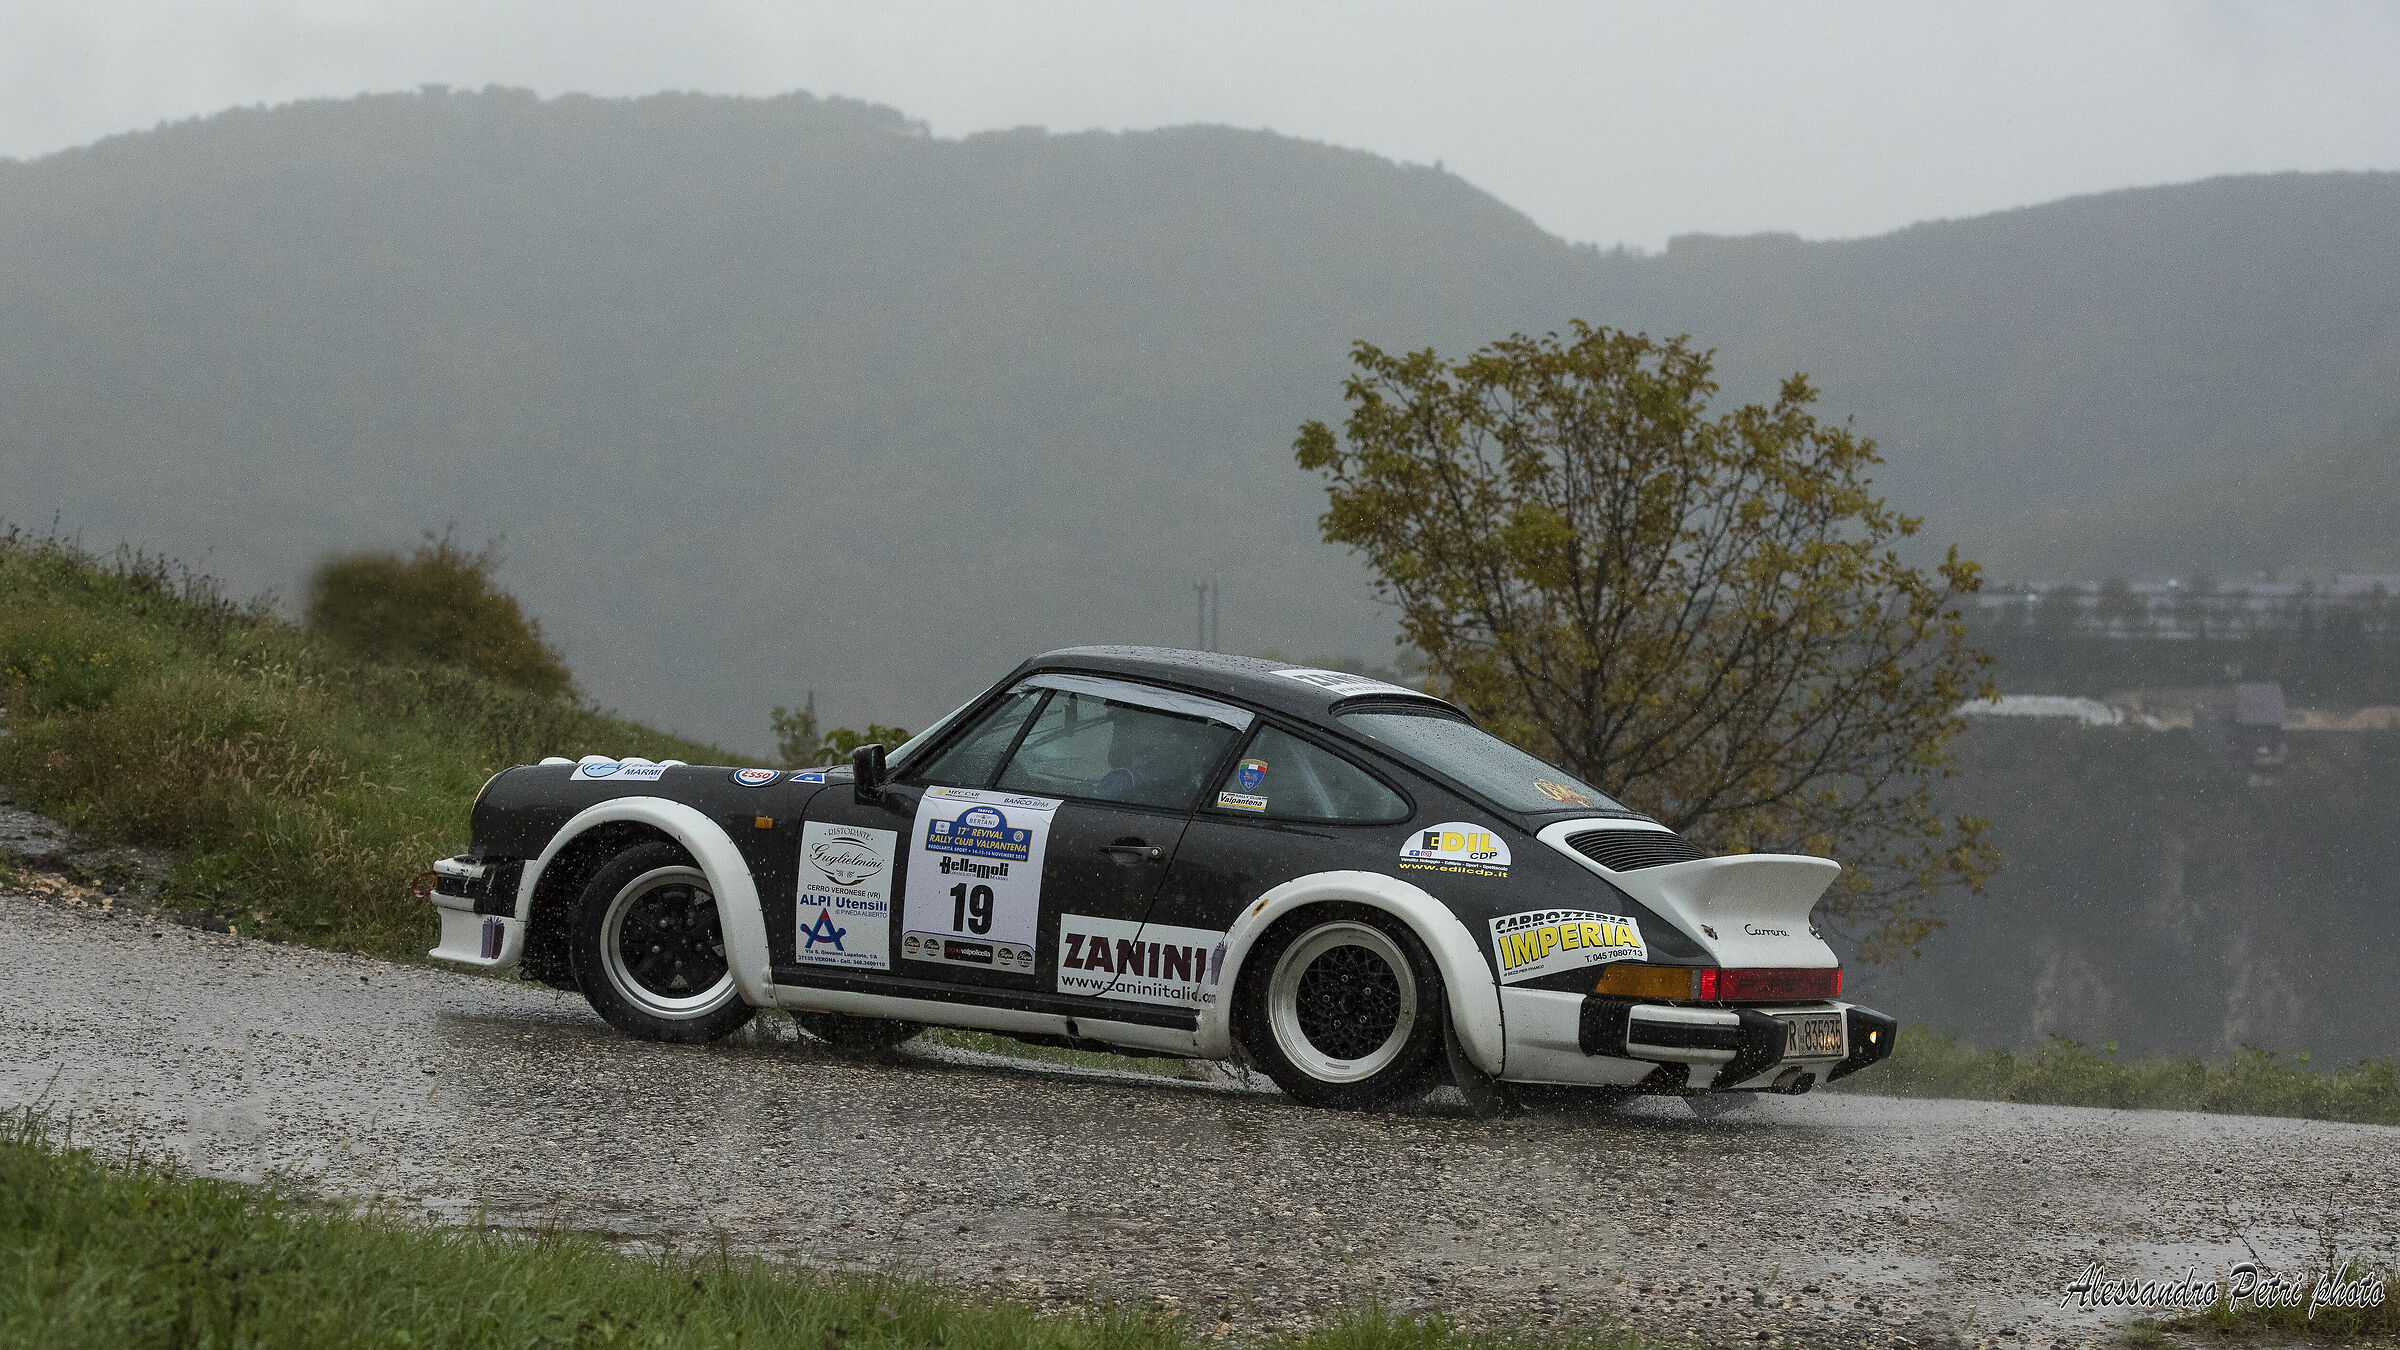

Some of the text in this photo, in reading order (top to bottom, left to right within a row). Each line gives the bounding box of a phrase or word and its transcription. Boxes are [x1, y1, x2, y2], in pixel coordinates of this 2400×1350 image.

[624, 768, 662, 776] MARMI
[1003, 797, 1032, 806] BANCO
[1220, 792, 1263, 807] Valpantena
[969, 817, 997, 827] BERTANI
[828, 827, 871, 841] RISTORANTE
[971, 828, 1003, 840] REVIVAL
[929, 834, 954, 844] RALLY
[954, 836, 974, 846] CLUB
[976, 839, 1027, 853] VALPANTENA
[1421, 831, 1497, 853] EDIL
[809, 842, 885, 869] Guglielmini
[991, 851, 1015, 859] NOVEMBRE
[1469, 852, 1498, 860] CDP
[1399, 863, 1508, 878] www.edilcdp.it
[1482, 864, 1509, 872] Spettacolo
[807, 883, 881, 900] CERRO VERONESE (VR)
[800, 894, 888, 912] ALPI Utensili
[949, 882, 994, 935] 19
[861, 911, 888, 919] ALBERTO
[1495, 911, 1630, 934] CARROZZERIA
[1744, 923, 1789, 937] Carrera
[1498, 922, 1641, 972] IMPERIA
[1608, 949, 1643, 958] 7080713
[1062, 932, 1208, 984] ZANINI
[1804, 1019, 1842, 1051] 835235
